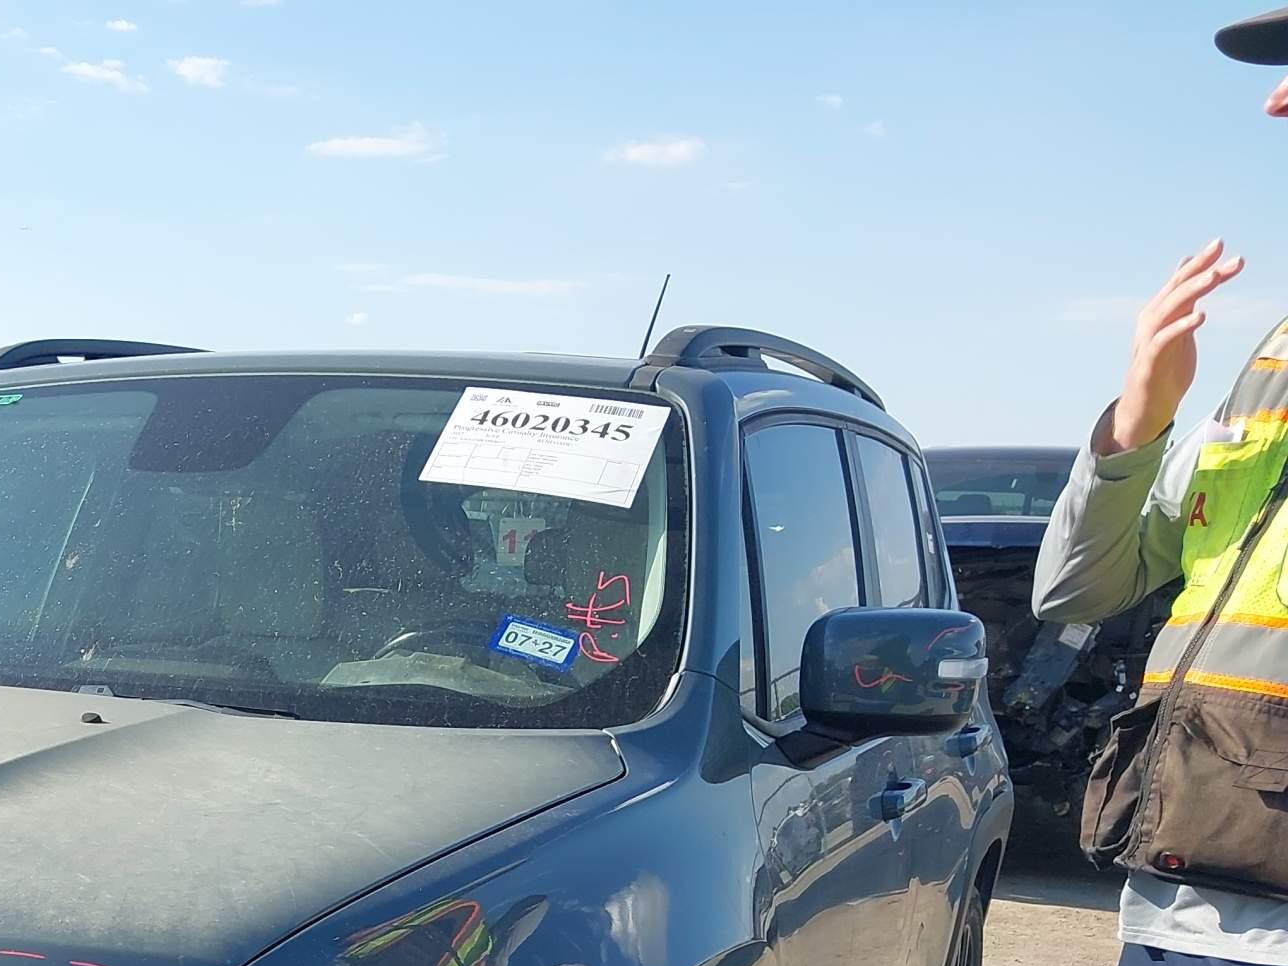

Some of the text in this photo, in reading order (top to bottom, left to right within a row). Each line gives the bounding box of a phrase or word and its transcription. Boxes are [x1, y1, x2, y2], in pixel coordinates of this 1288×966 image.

[469, 408, 634, 442] 46020345
[504, 630, 534, 648] 07
[538, 640, 568, 657] 27
